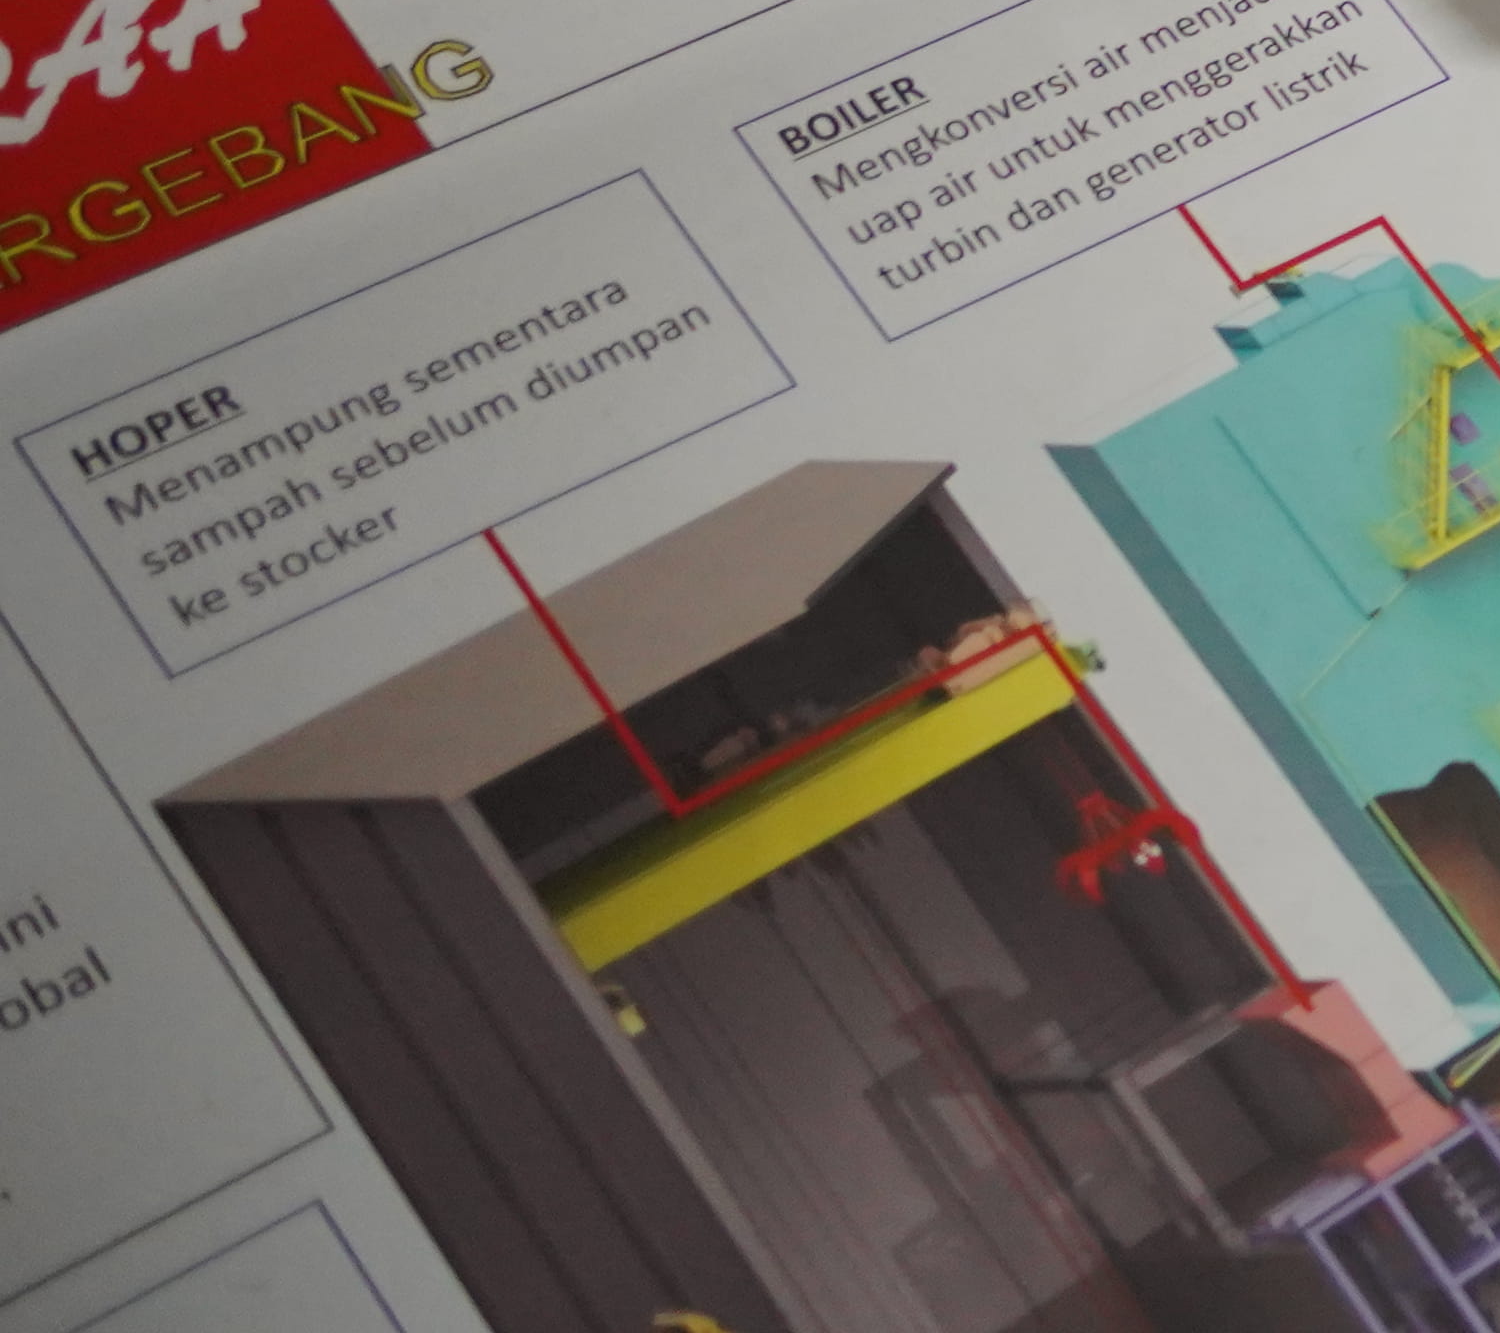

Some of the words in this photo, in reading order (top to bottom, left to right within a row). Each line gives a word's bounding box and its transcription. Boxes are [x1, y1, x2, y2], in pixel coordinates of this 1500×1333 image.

[0, 38, 494, 288] RGEBANG
[778, 75, 928, 156] BOILER
[811, 62, 1086, 200] Mengkonversi
[1084, 43, 1131, 82] air
[846, 197, 924, 247] uap
[931, 171, 977, 209] air
[988, 115, 1102, 183] untuk
[878, 218, 1002, 291] turbin
[1007, 185, 1084, 233] dan
[1084, 95, 1263, 203] generator
[1268, 49, 1369, 113] listrik
[69, 383, 242, 478] HOPER
[104, 383, 402, 527] Menampung
[404, 278, 630, 395] sementara
[142, 479, 323, 577] sampah
[331, 388, 519, 492] sebelum
[524, 303, 712, 404] diumpan
[168, 586, 230, 629] ke
[239, 504, 400, 600] stocker
